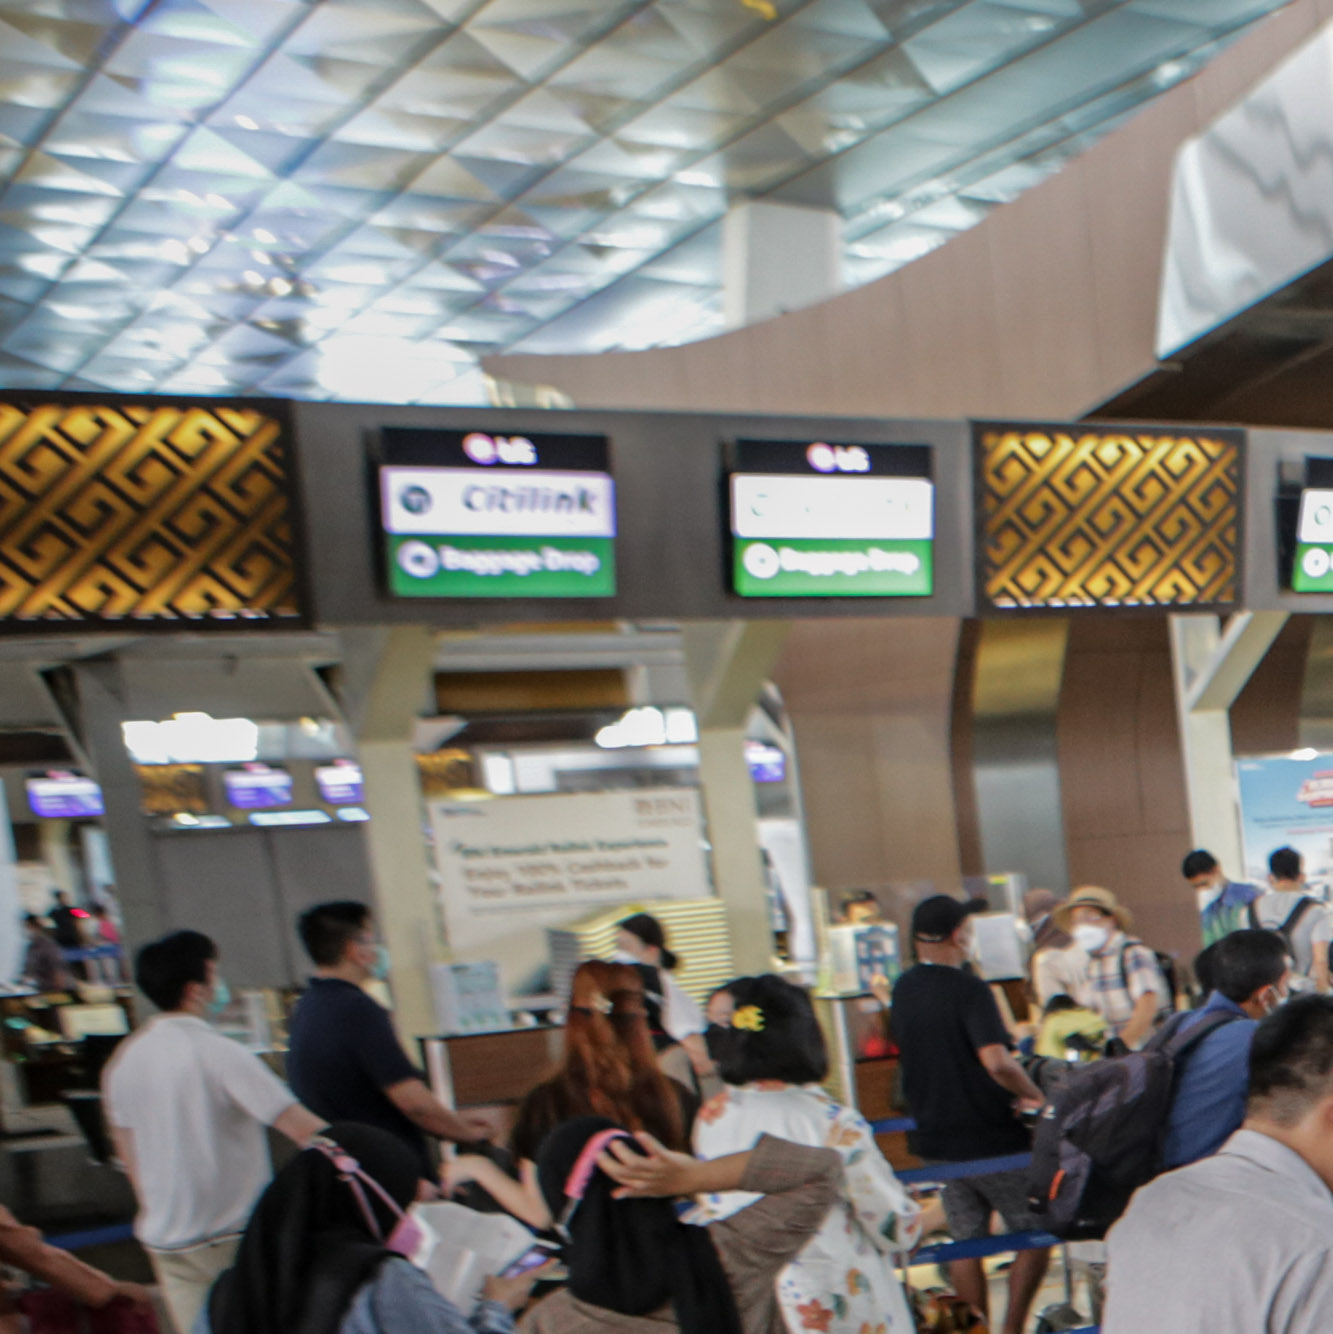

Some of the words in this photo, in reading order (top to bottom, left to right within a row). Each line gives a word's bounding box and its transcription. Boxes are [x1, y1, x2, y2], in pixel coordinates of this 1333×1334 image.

[462, 484, 597, 515] Citilink
[439, 545, 542, 575] Baggage
[541, 546, 600, 576] Drop
